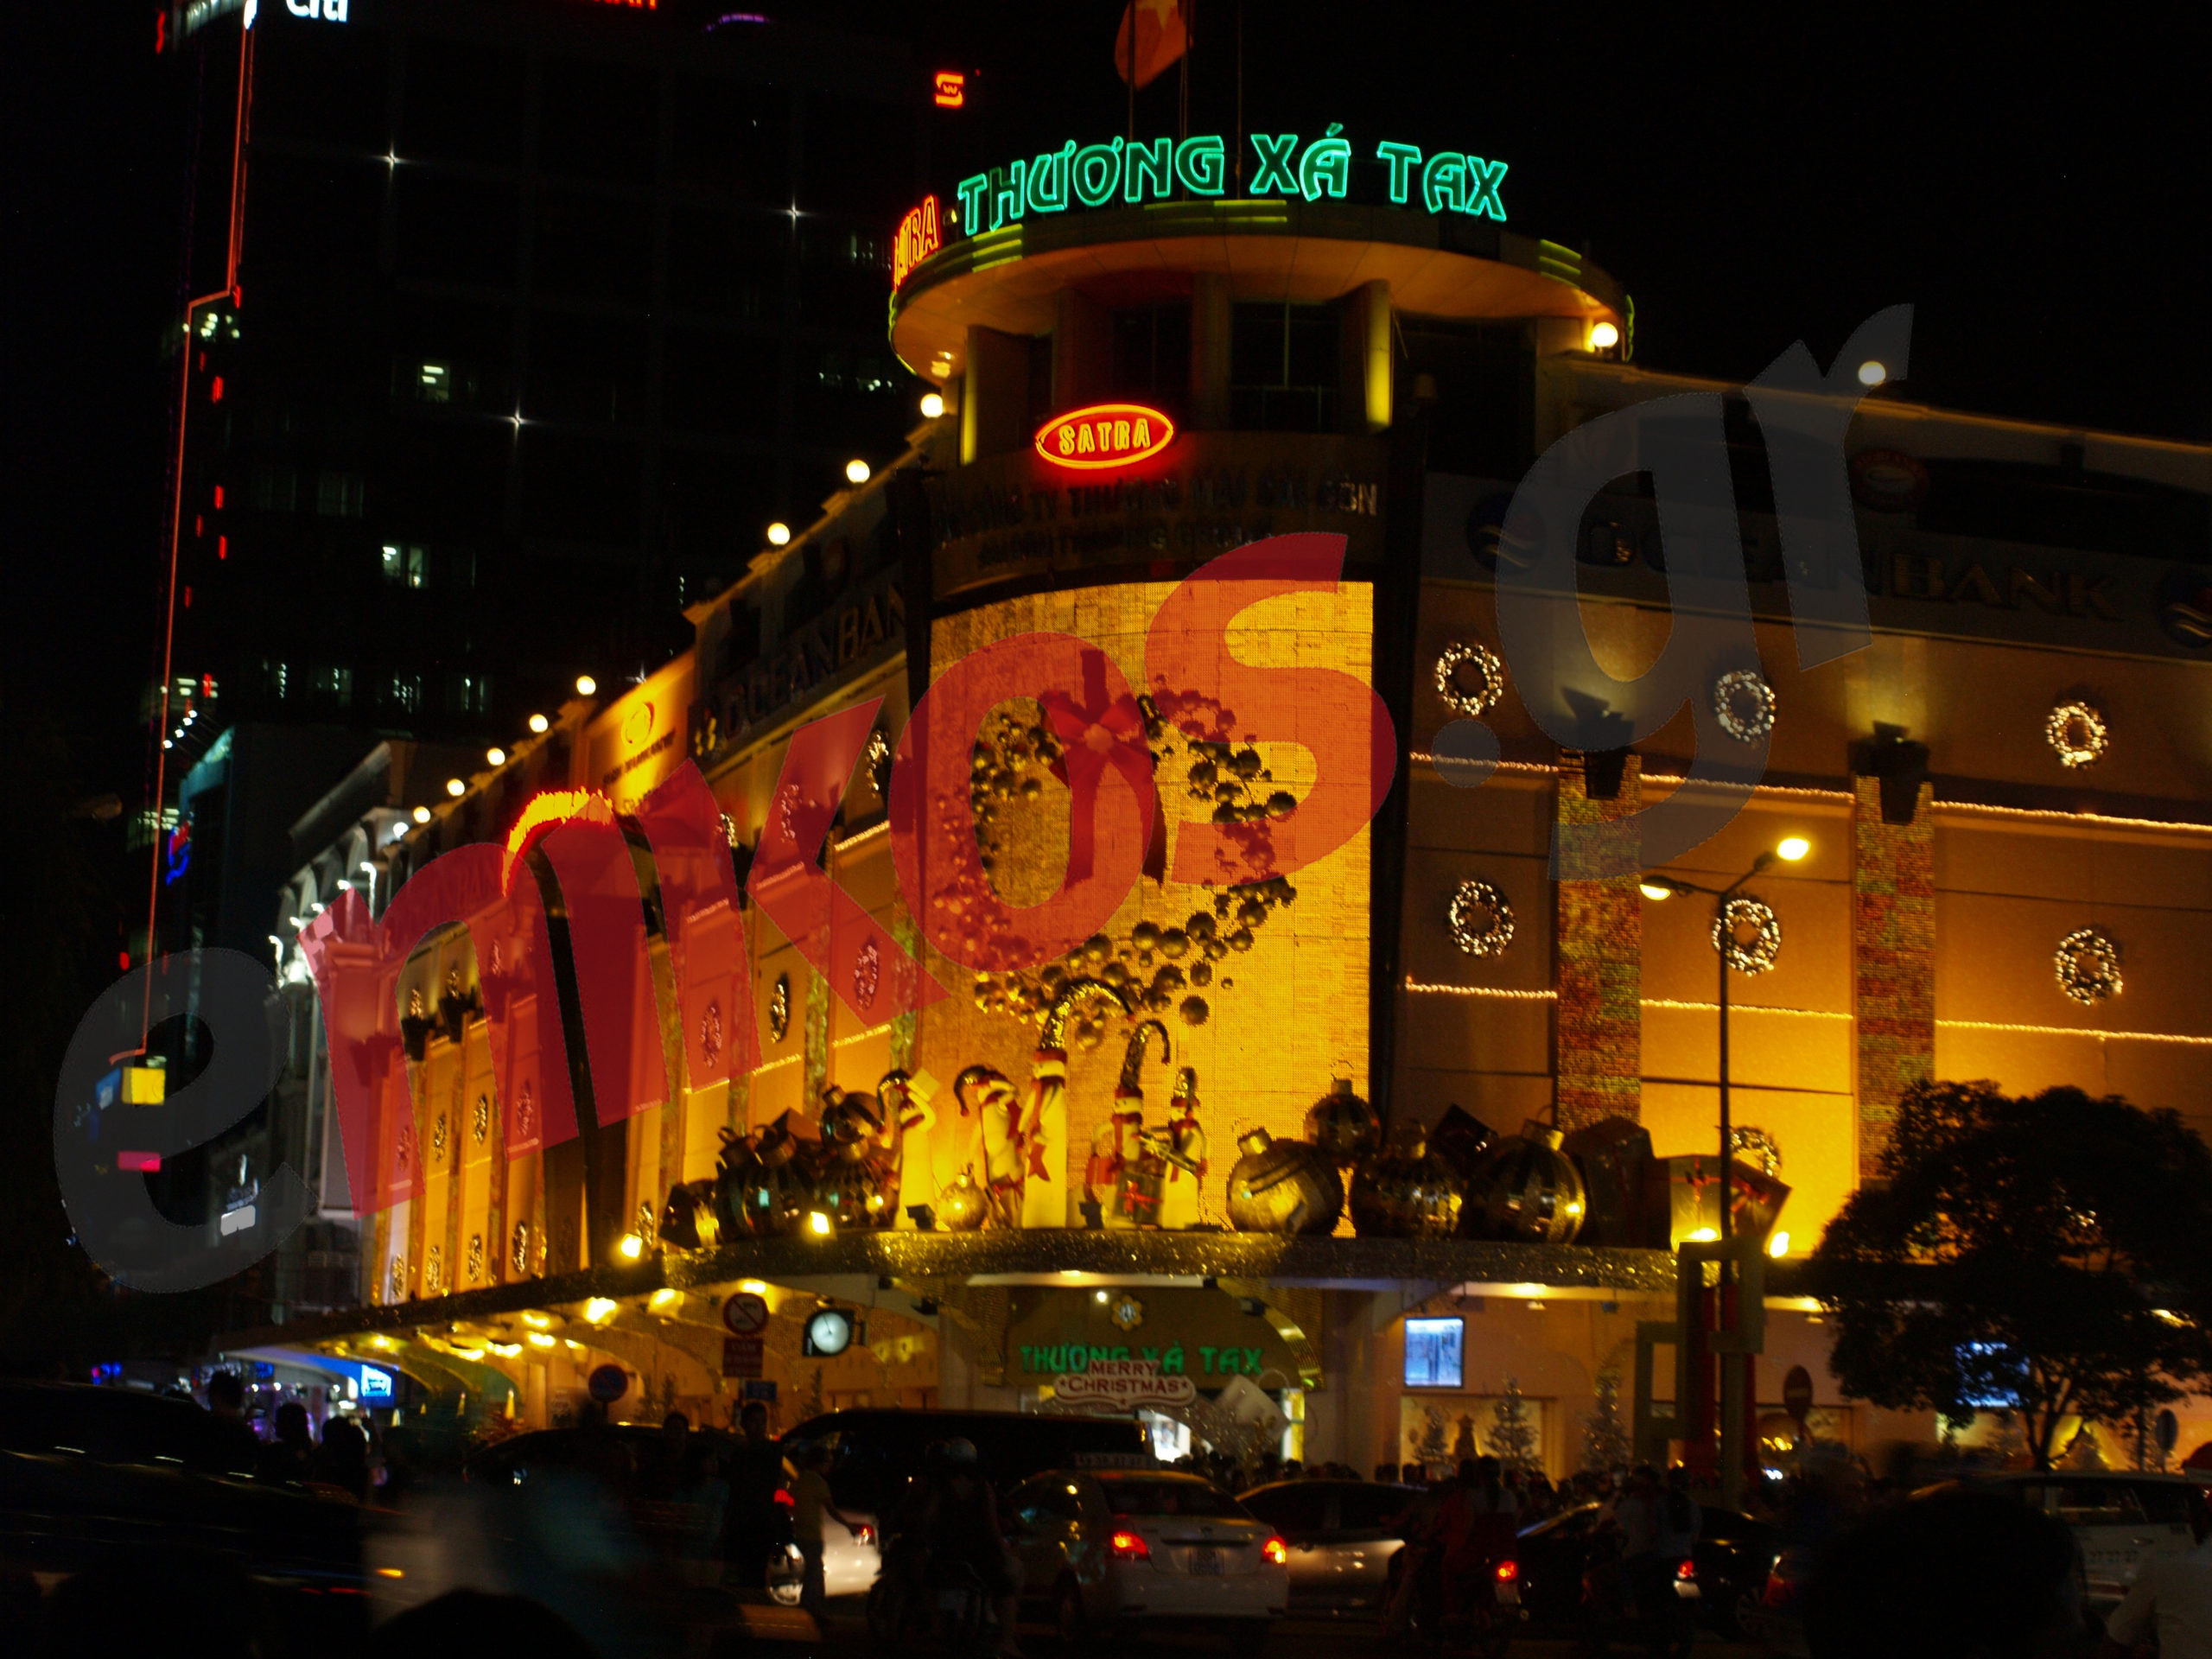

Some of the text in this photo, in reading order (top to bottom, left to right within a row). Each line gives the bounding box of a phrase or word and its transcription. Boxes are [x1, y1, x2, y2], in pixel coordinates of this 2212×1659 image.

[957, 122, 1510, 238] THƯƠNG XÁ TAX
[1058, 417, 1151, 455] SATRA
[1090, 1361, 1159, 1376] MERRY
[1198, 1346, 1263, 1374] TAX
[1068, 1376, 1180, 1395] CHRISTMAS
